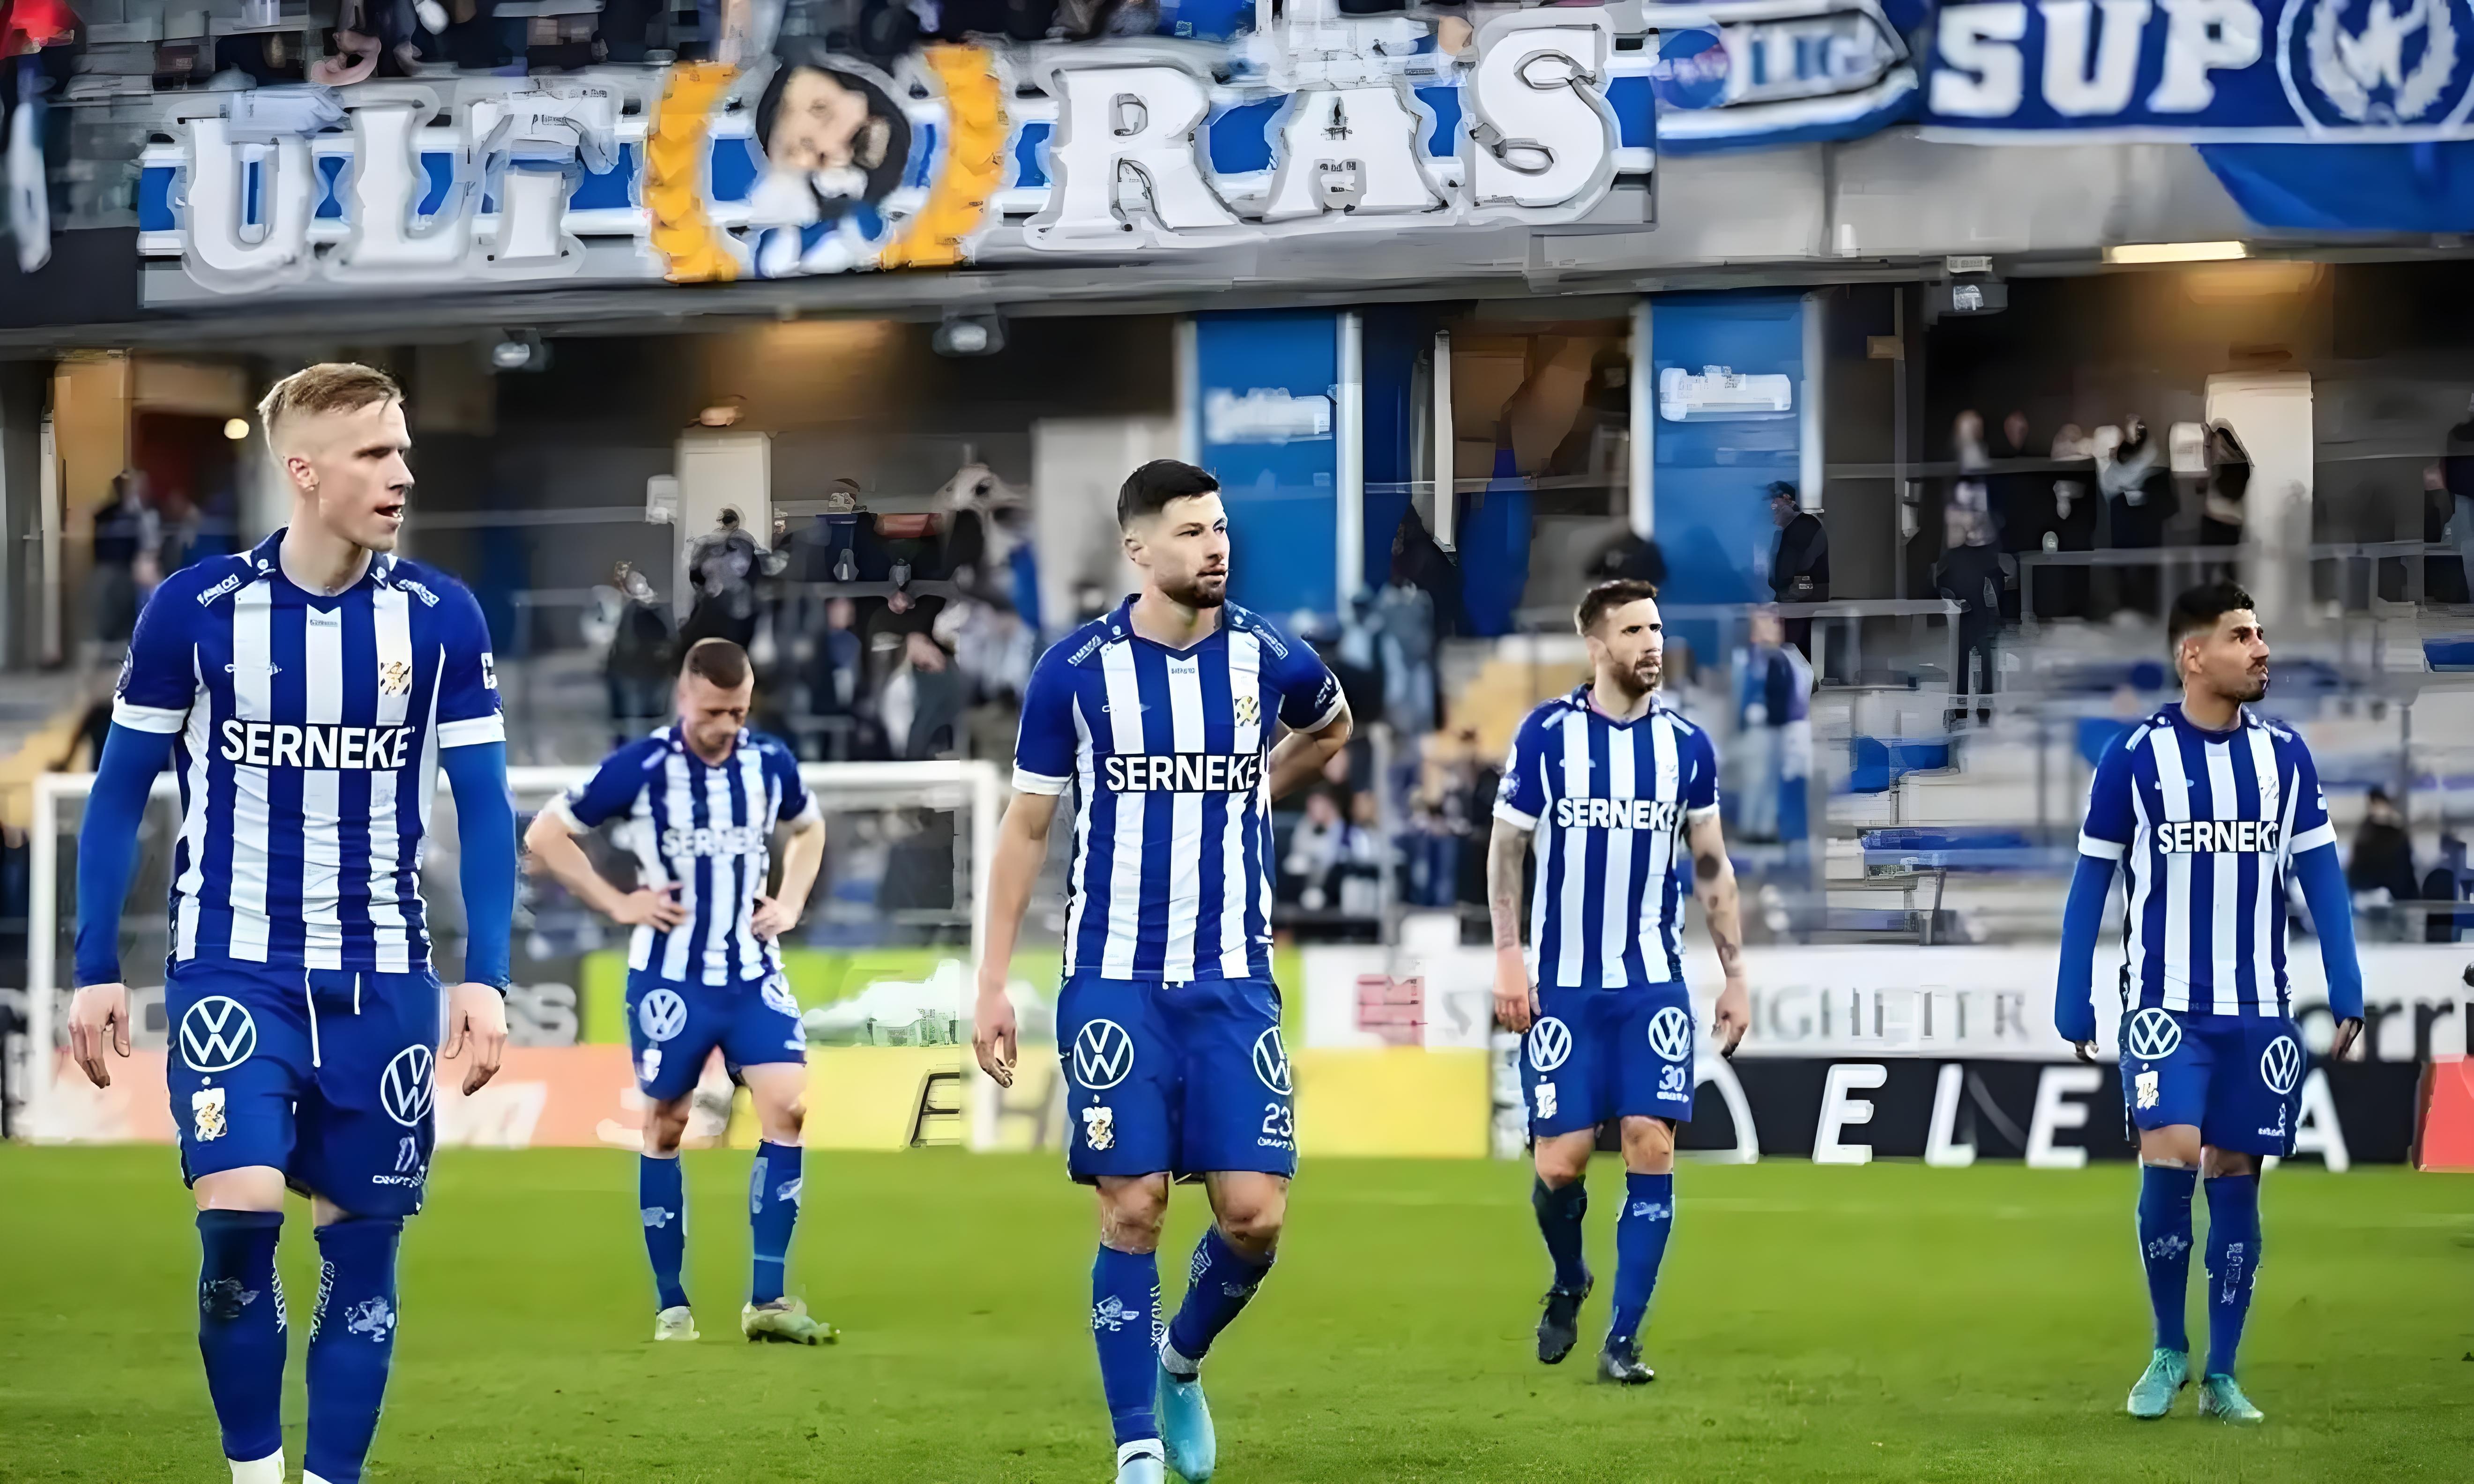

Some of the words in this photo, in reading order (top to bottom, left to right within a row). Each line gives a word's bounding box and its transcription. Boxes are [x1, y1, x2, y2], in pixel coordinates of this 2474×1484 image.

[1930, 0, 2263, 117] SUP
[221, 719, 410, 769] SERNEKE
[1105, 753, 1260, 791] SERNEKE
[179, 995, 257, 1072] VW
[1073, 1018, 1134, 1090] VW
[1528, 1016, 1572, 1072] VW
[1648, 1006, 1691, 1062] VW
[2129, 1007, 2182, 1060] VW
[2260, 1035, 2300, 1095] VW
[1262, 1102, 1293, 1137] 23
